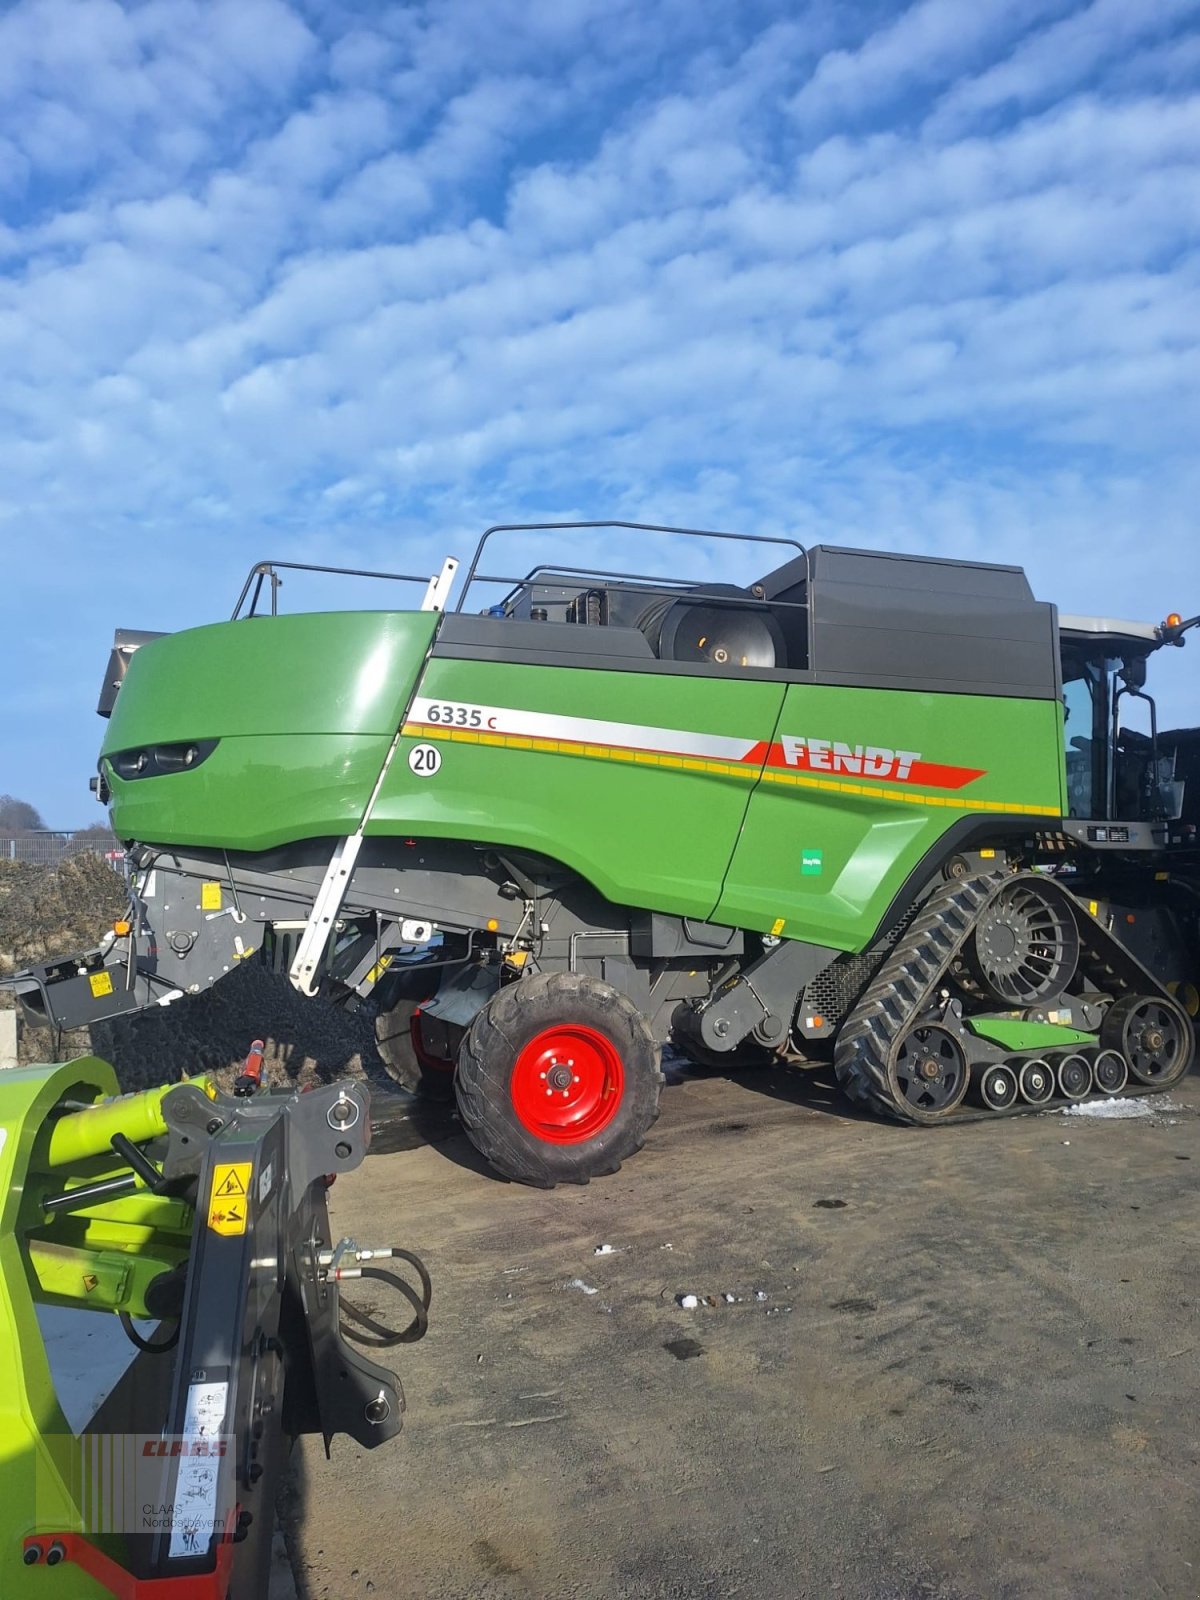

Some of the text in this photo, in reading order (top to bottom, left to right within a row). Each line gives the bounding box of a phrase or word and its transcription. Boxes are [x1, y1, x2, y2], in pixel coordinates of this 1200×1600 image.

[427, 704, 482, 728] 6335
[413, 749, 436, 770] 20
[781, 734, 922, 779] FENDT
